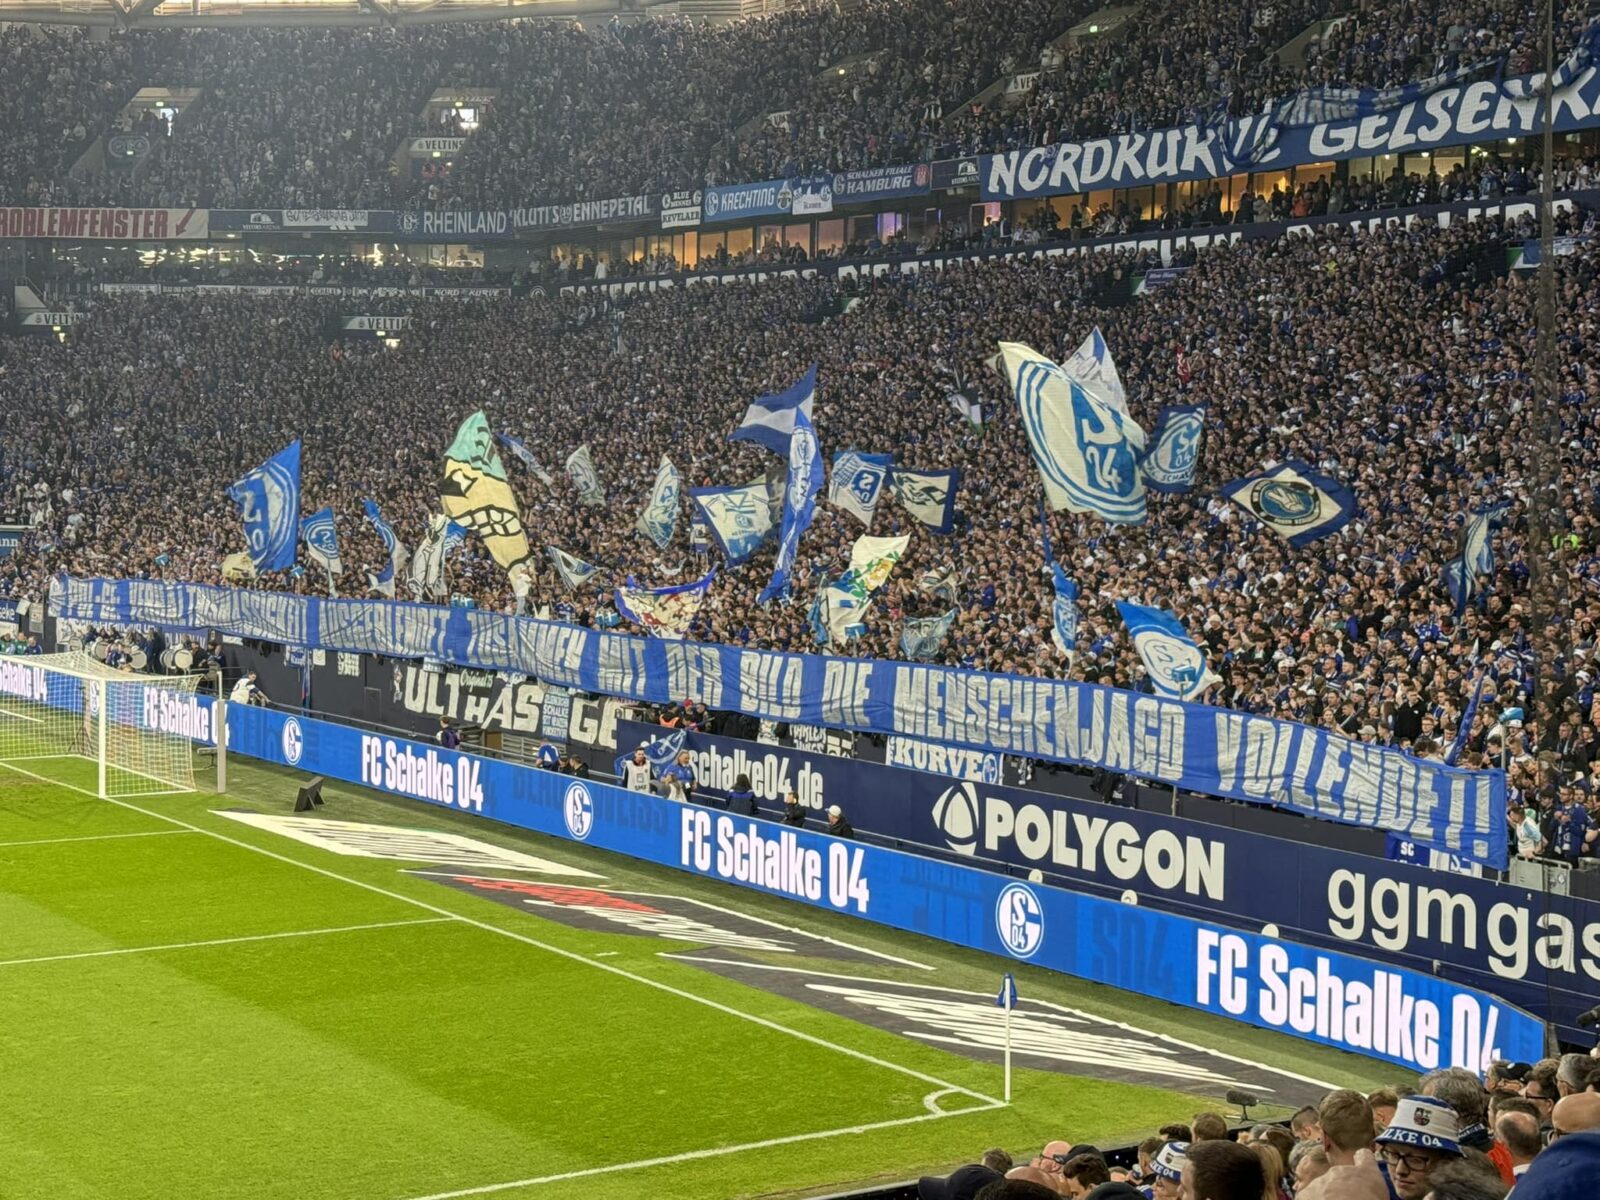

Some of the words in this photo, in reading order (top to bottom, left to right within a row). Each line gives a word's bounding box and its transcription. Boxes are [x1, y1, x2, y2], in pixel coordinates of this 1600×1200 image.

[847, 167, 884, 180] SCHALKER
[847, 175, 913, 194] HAMBURG
[573, 195, 651, 222] ENNEPETAL
[721, 187, 775, 211] KRECHTING
[424, 211, 506, 234] RHEINLAND
[144, 686, 158, 729] FC
[160, 690, 209, 741] Schalke
[466, 612, 588, 686] ZUSAMMEN
[598, 635, 646, 697] MIT
[665, 643, 723, 707] DER
[739, 651, 804, 719] BILD
[821, 660, 874, 727] DIE
[893, 666, 1185, 781] MENSCHENJAGD
[362, 735, 382, 787] FC
[385, 739, 453, 800] Schalke
[458, 756, 484, 811] 04
[894, 737, 983, 781] KURVE
[681, 807, 711, 872] FC
[717, 815, 821, 900] Schalke
[829, 842, 869, 913] 04
[985, 797, 1225, 901] POLYGON
[1196, 927, 1248, 1015] FC
[1259, 943, 1439, 1069] Schalke
[1451, 993, 1500, 1083] 04
[1421, 1135, 1443, 1148] 04
